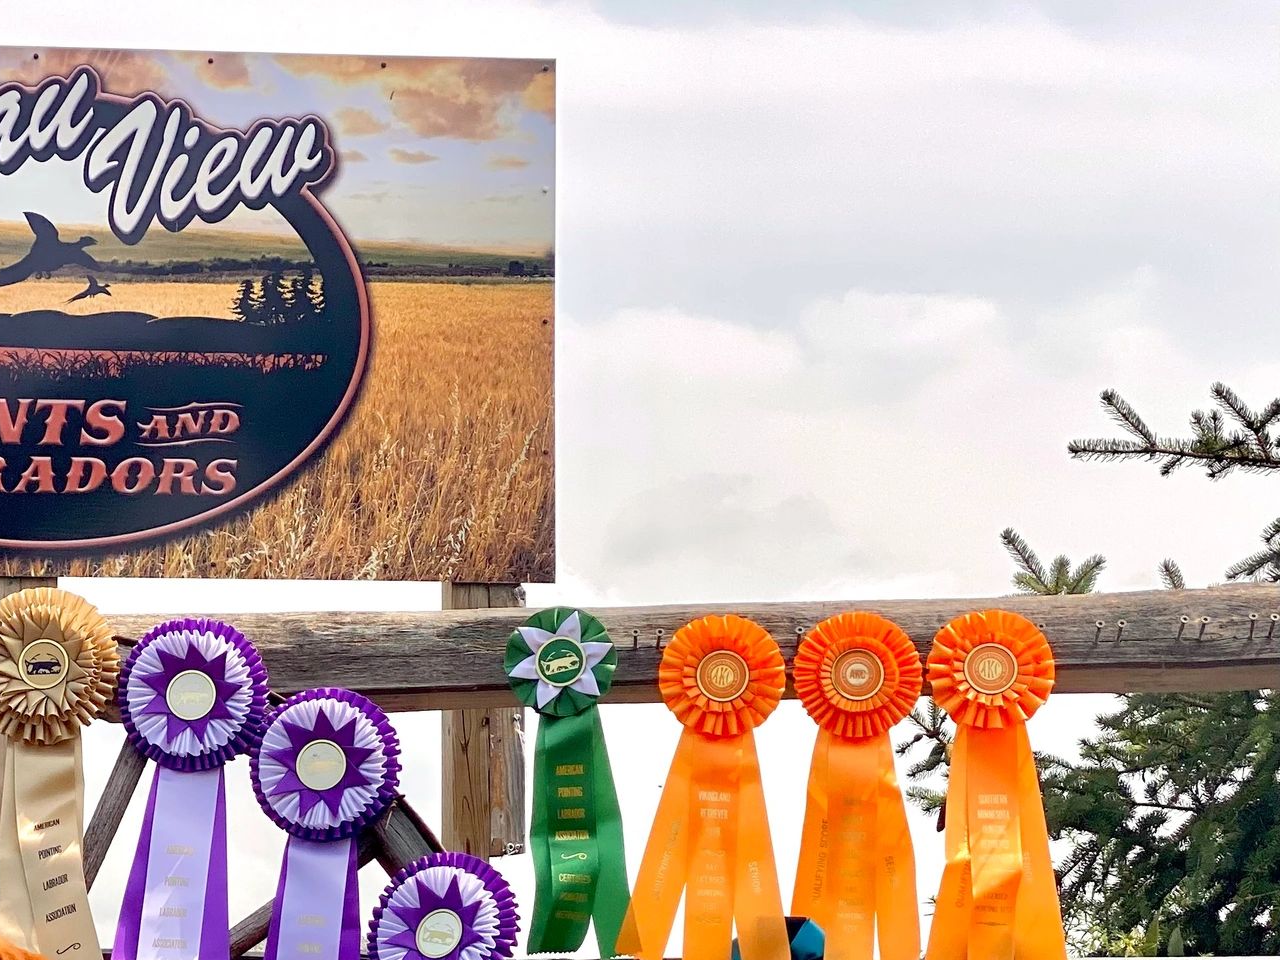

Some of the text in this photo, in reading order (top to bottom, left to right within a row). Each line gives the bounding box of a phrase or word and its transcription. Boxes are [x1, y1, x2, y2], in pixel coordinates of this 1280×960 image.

[88, 100, 322, 235] View
[136, 407, 242, 437] AND
[712, 667, 733, 686] AKC
[849, 669, 867, 680] AKC
[981, 660, 1001, 679] AKC
[33, 818, 61, 832] AMERICAN
[820, 818, 829, 849] SCORE
[37, 844, 62, 861] POINTING
[42, 873, 69, 892] LABRADOR
[44, 903, 78, 925] ASSOCIATION
